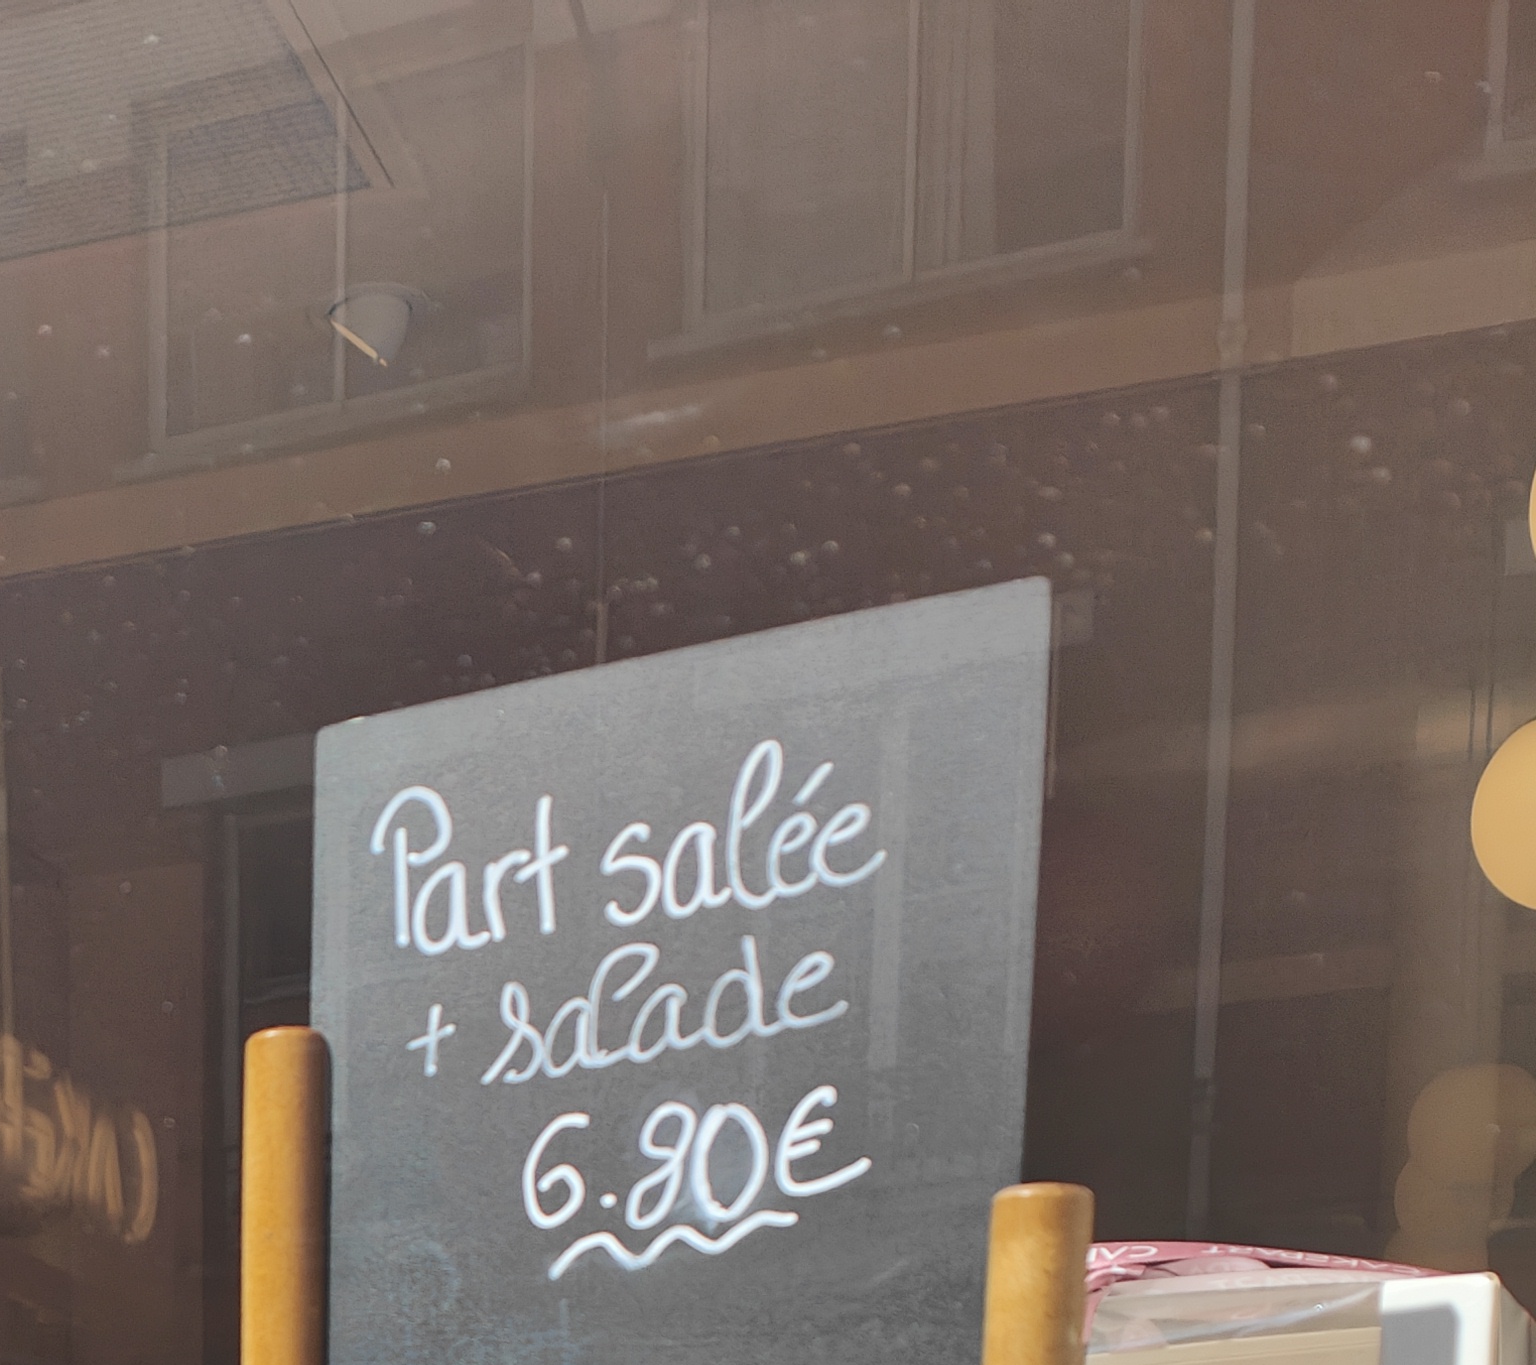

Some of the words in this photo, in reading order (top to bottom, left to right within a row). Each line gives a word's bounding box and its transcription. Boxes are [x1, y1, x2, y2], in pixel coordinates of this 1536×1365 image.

[371, 785, 570, 954] Part
[600, 739, 887, 926] salée
[480, 935, 849, 1085] salade
